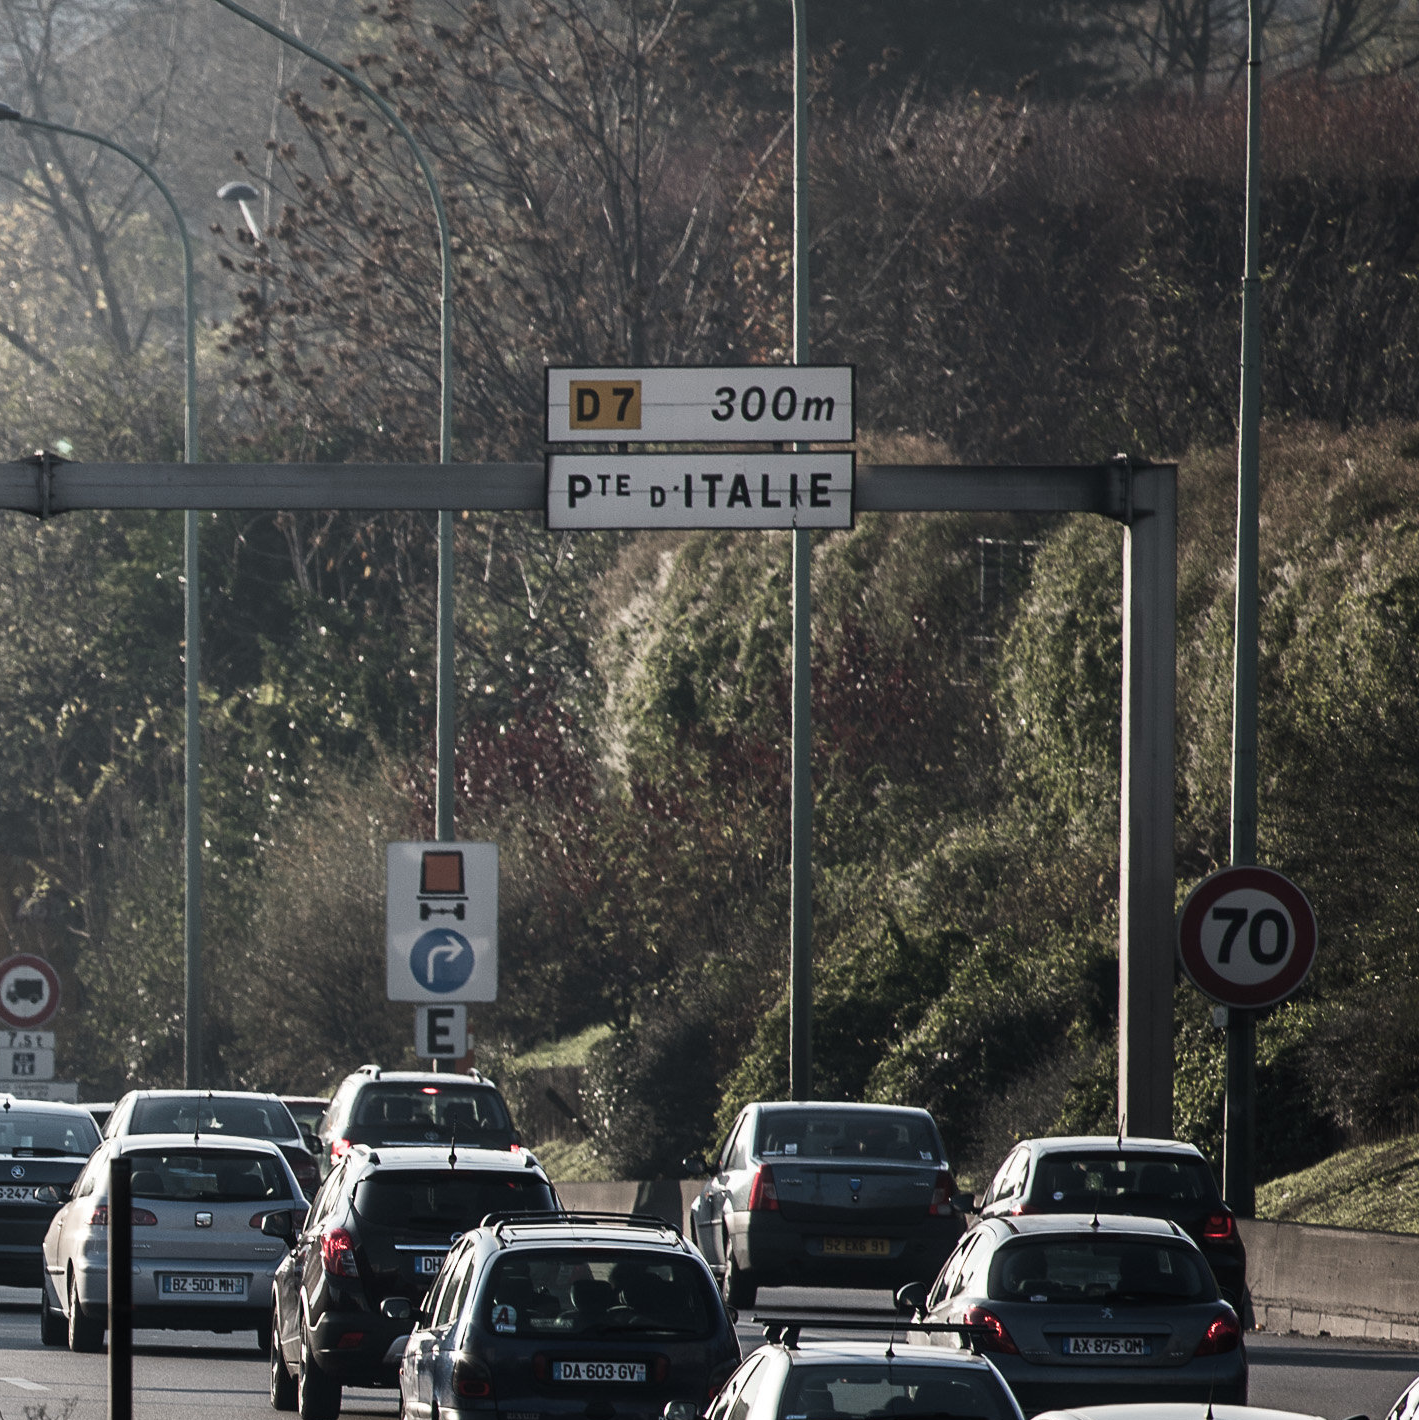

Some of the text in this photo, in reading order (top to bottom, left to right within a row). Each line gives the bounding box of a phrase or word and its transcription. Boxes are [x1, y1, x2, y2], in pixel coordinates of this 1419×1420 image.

[1212, 907, 1289, 966] 70
[426, 1007, 455, 1055] E
[562, 1362, 638, 1381] DA-603-GV
